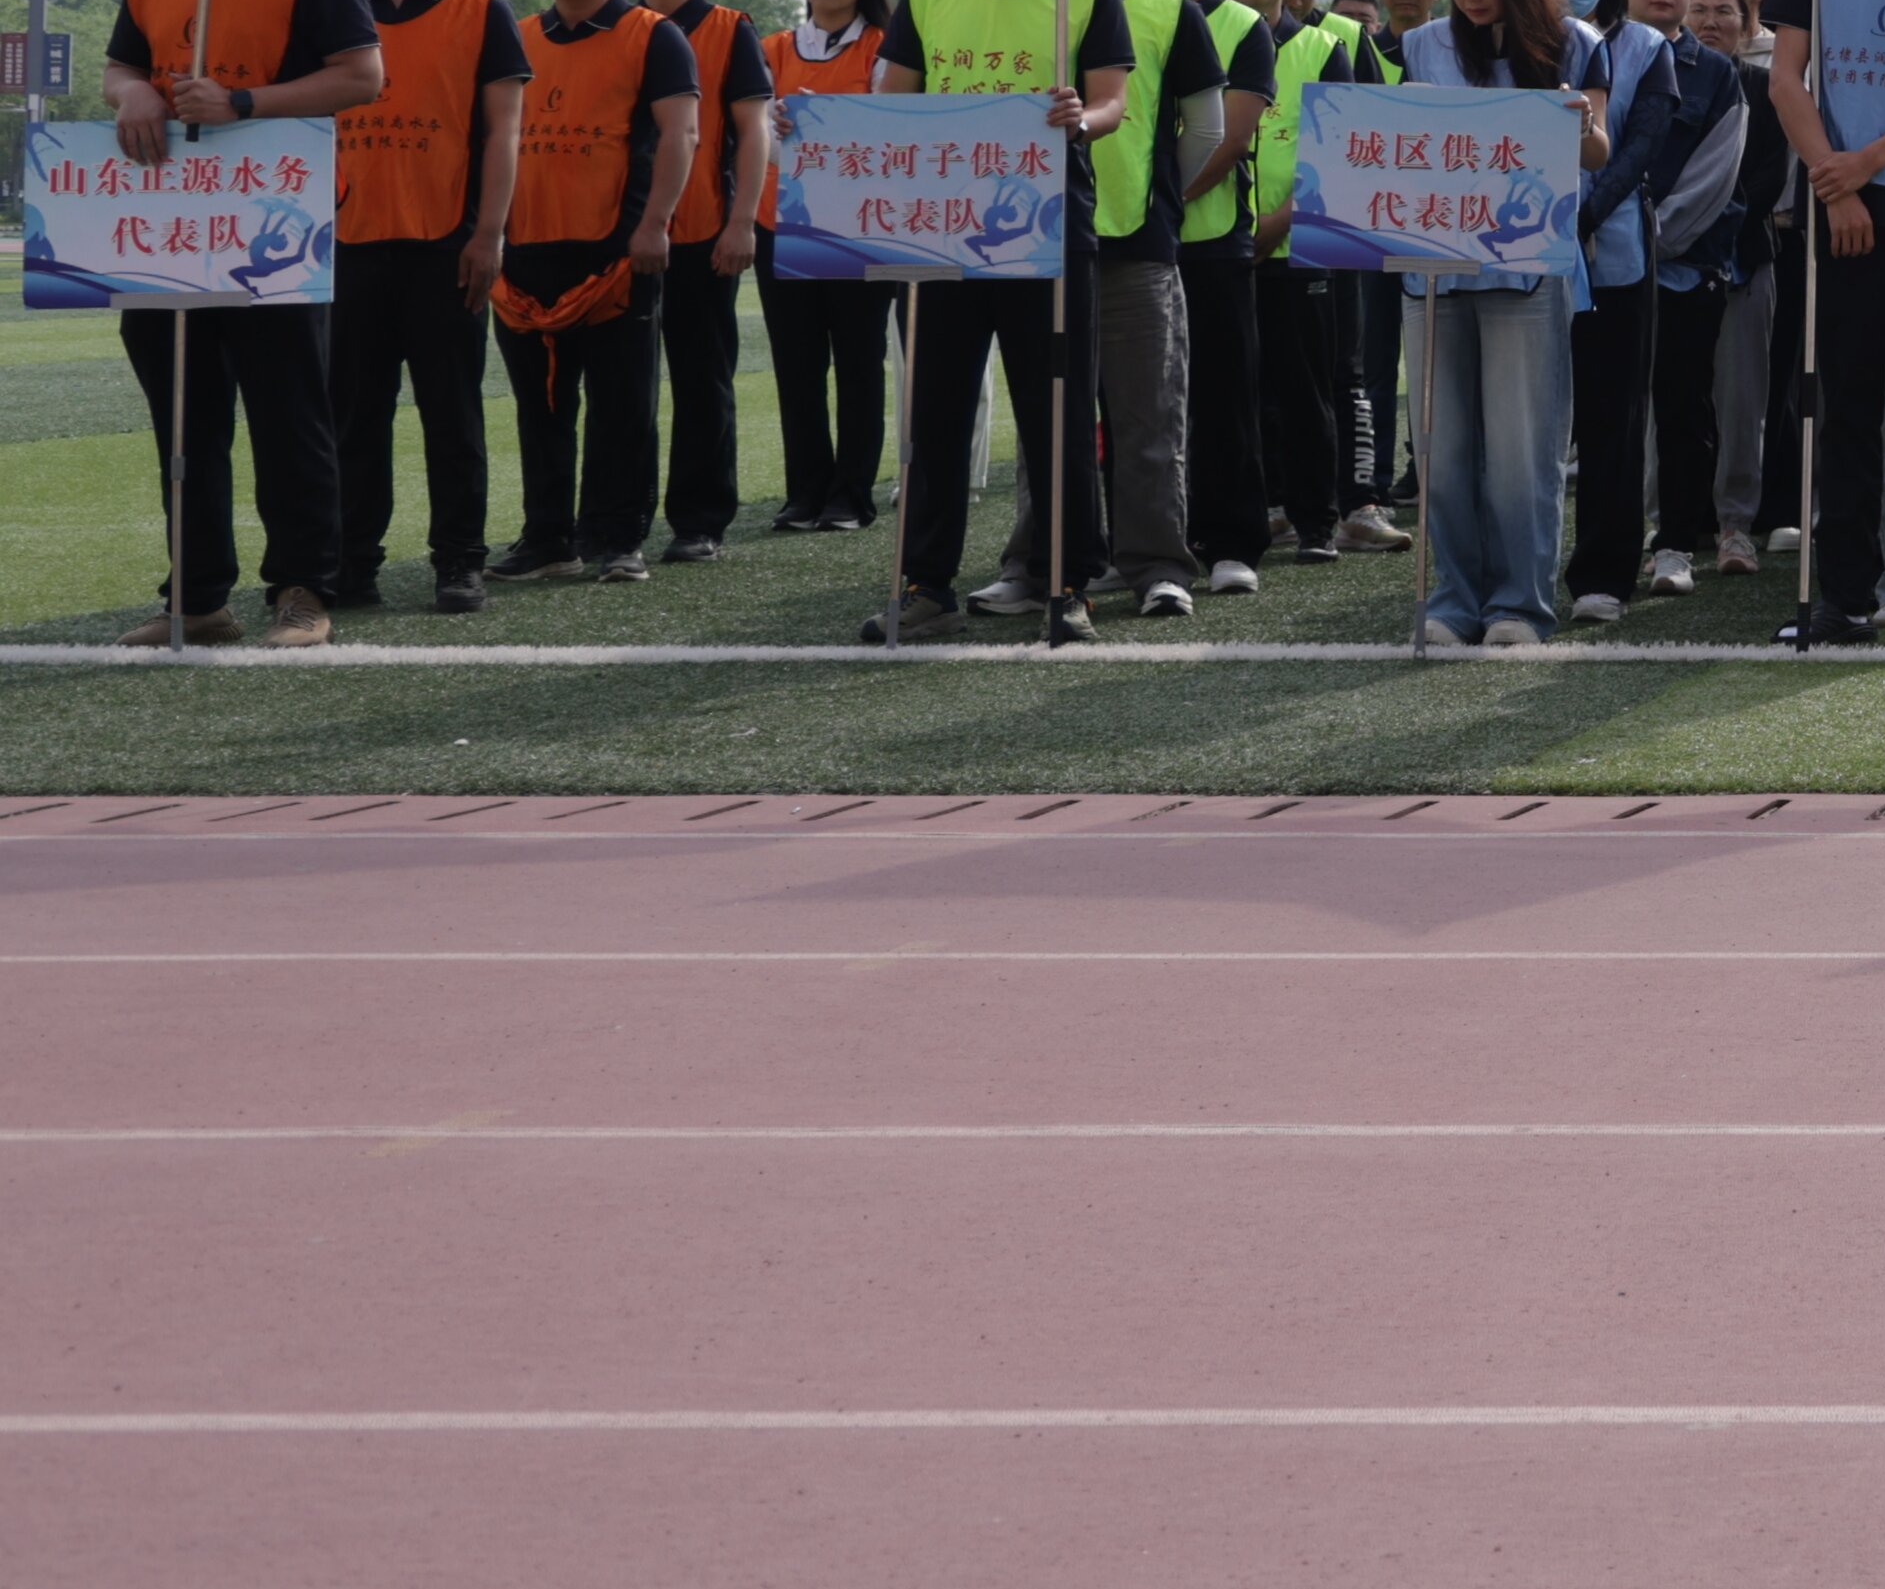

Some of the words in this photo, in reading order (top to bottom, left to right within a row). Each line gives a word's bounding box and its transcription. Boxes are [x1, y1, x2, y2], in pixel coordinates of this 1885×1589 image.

[791, 141, 1054, 180] 芦家河子供水
[1346, 131, 1527, 173] 城区供水
[48, 155, 312, 197] 山东正源水务
[856, 197, 986, 235] 代表队
[1367, 190, 1500, 231] 代表队
[111, 214, 247, 256] 代表队
